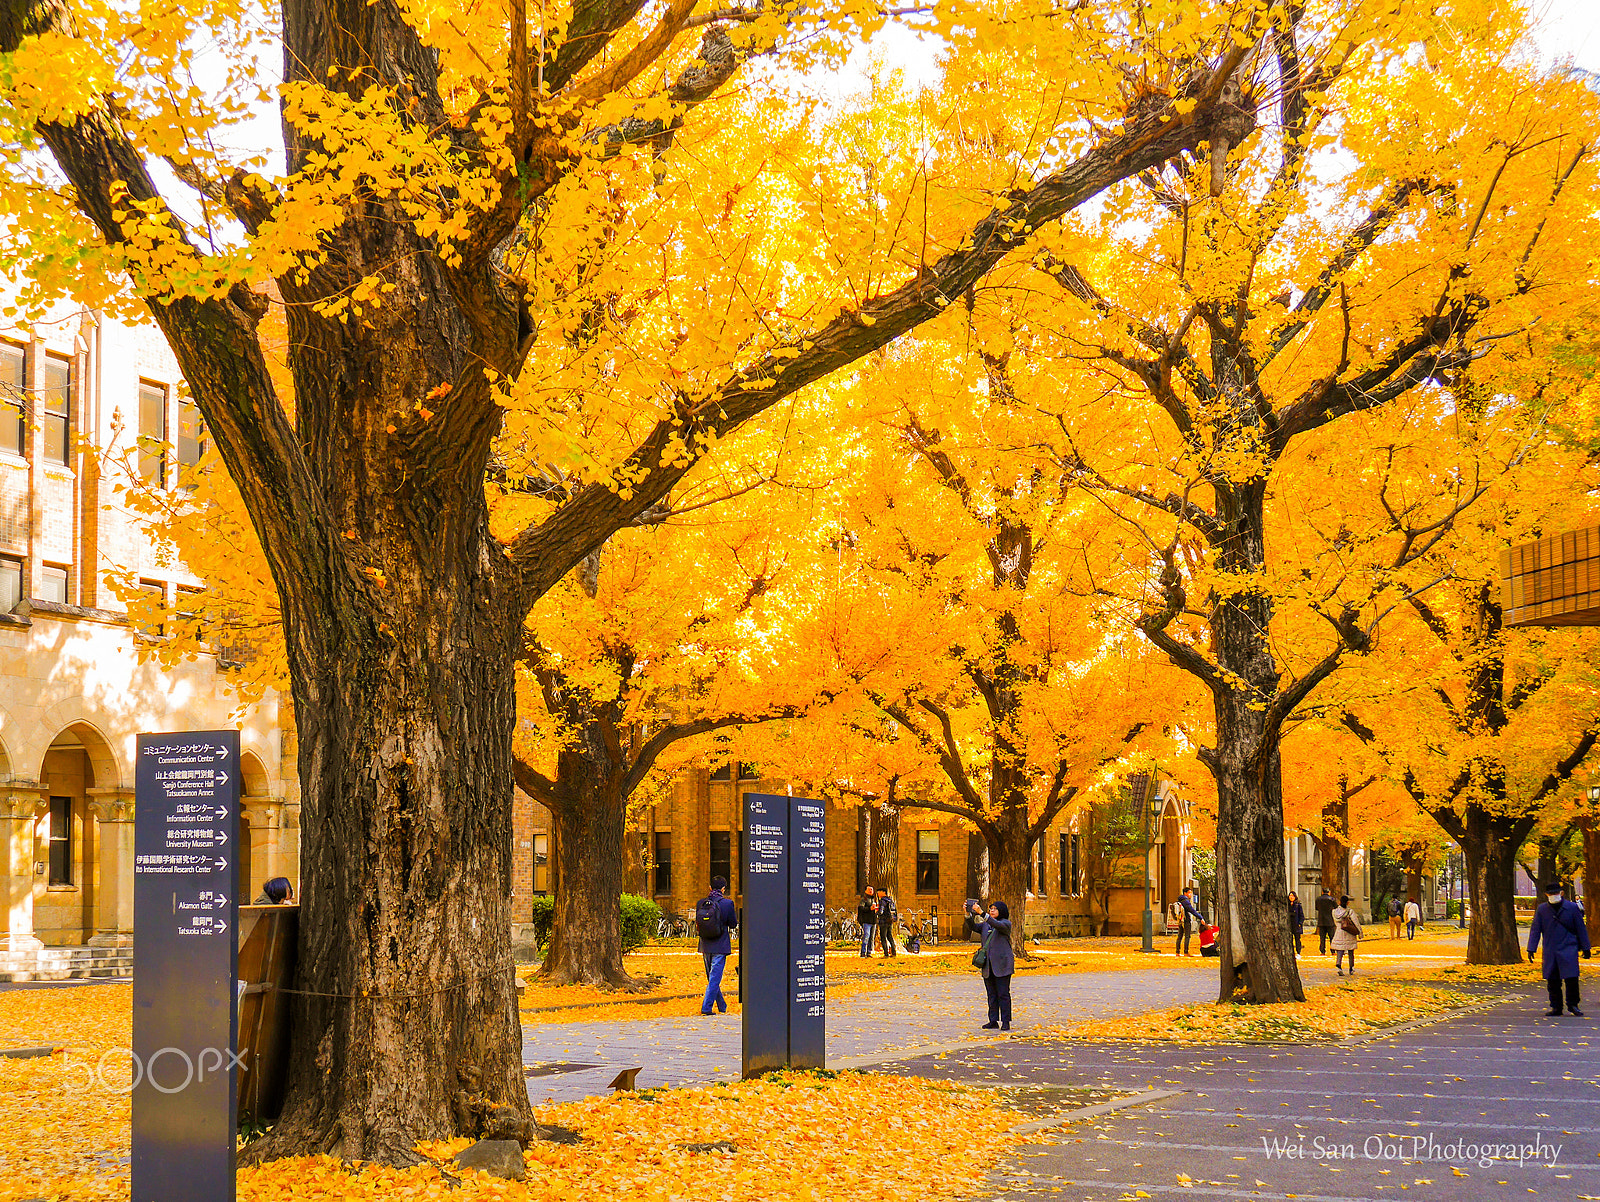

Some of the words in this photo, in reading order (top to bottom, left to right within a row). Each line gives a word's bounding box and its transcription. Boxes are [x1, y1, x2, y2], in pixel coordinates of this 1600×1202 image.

[144, 744, 214, 756] コミュニケーションセンター
[158, 756, 196, 764] Communication
[176, 804, 214, 813] 広報センター
[167, 829, 214, 838] 総合研究博物館
[166, 840, 191, 849] University
[136, 855, 213, 864] 伊藤国際学術研究センター
[199, 891, 213, 900] 赤門
[178, 927, 199, 935] Tatsuoka
